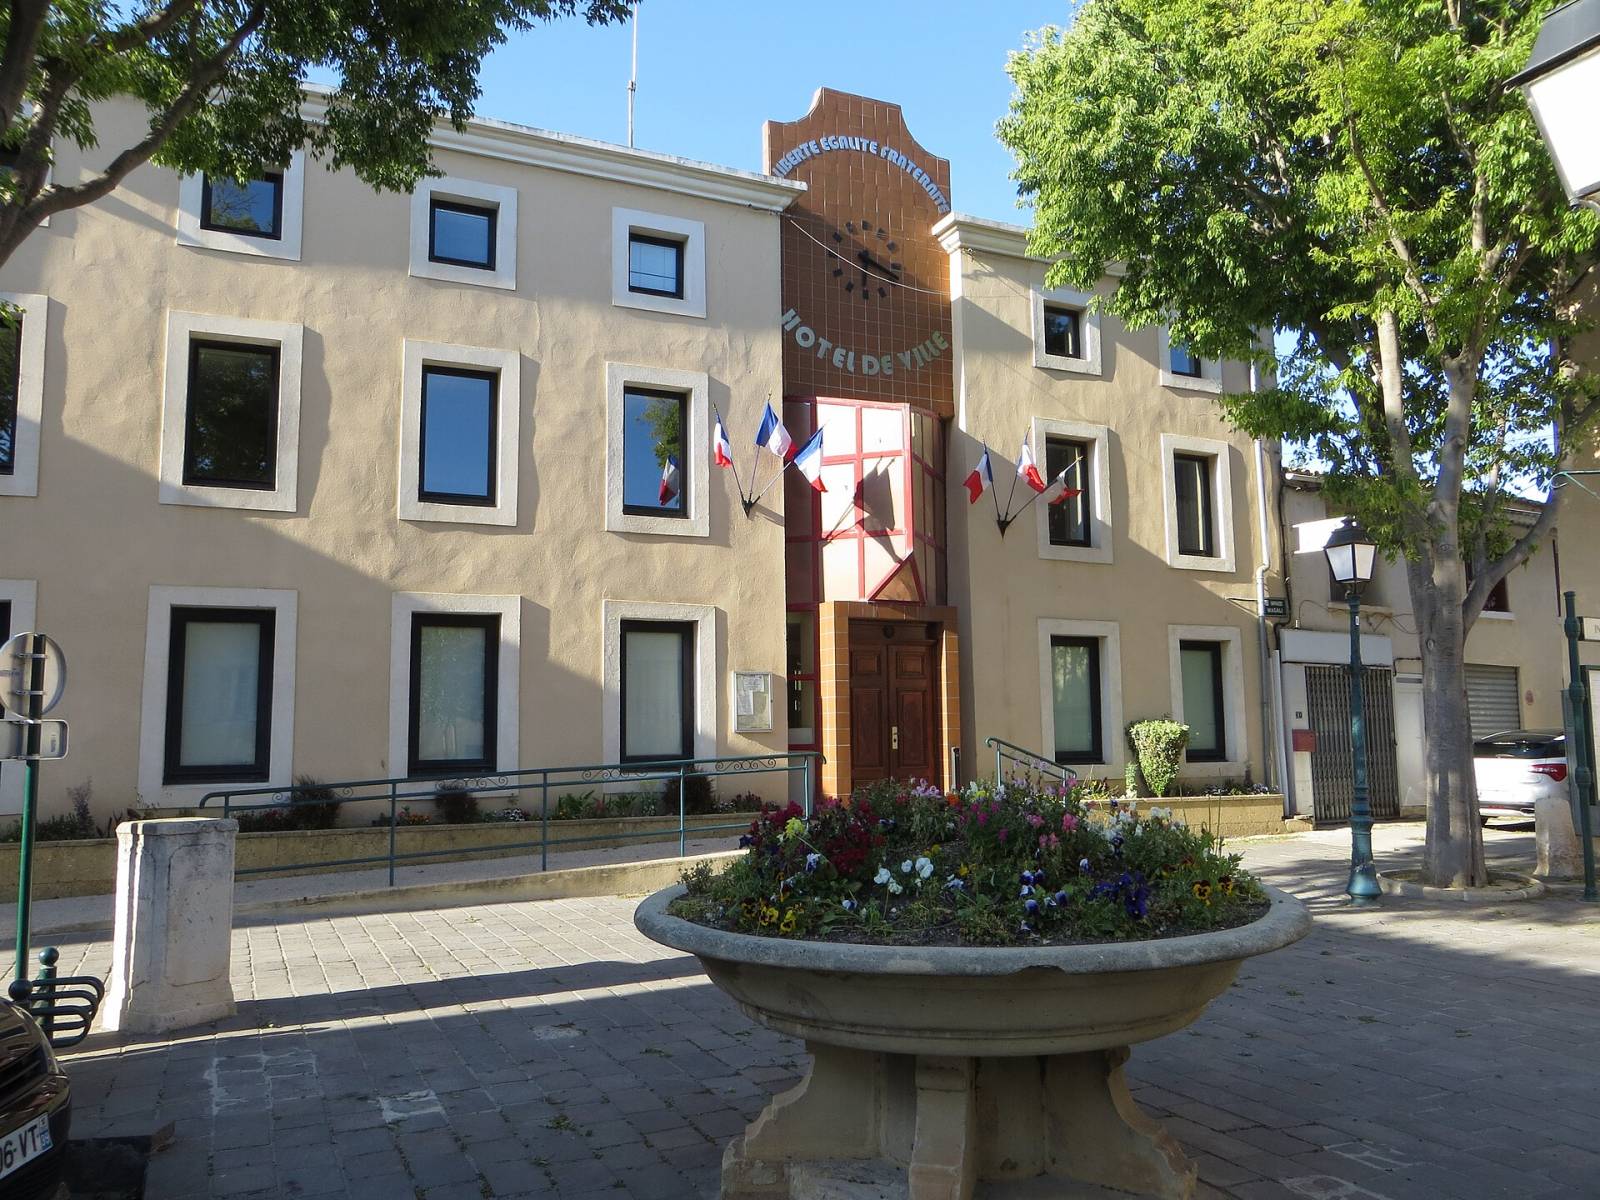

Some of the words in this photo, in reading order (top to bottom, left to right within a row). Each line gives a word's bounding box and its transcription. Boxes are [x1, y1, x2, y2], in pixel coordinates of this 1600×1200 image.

[819, 135, 880, 155] EGALITE
[881, 146, 951, 214] FRATERNITE
[781, 308, 856, 374] HOTEL
[861, 354, 894, 376] DE
[897, 330, 949, 371] VILLE
